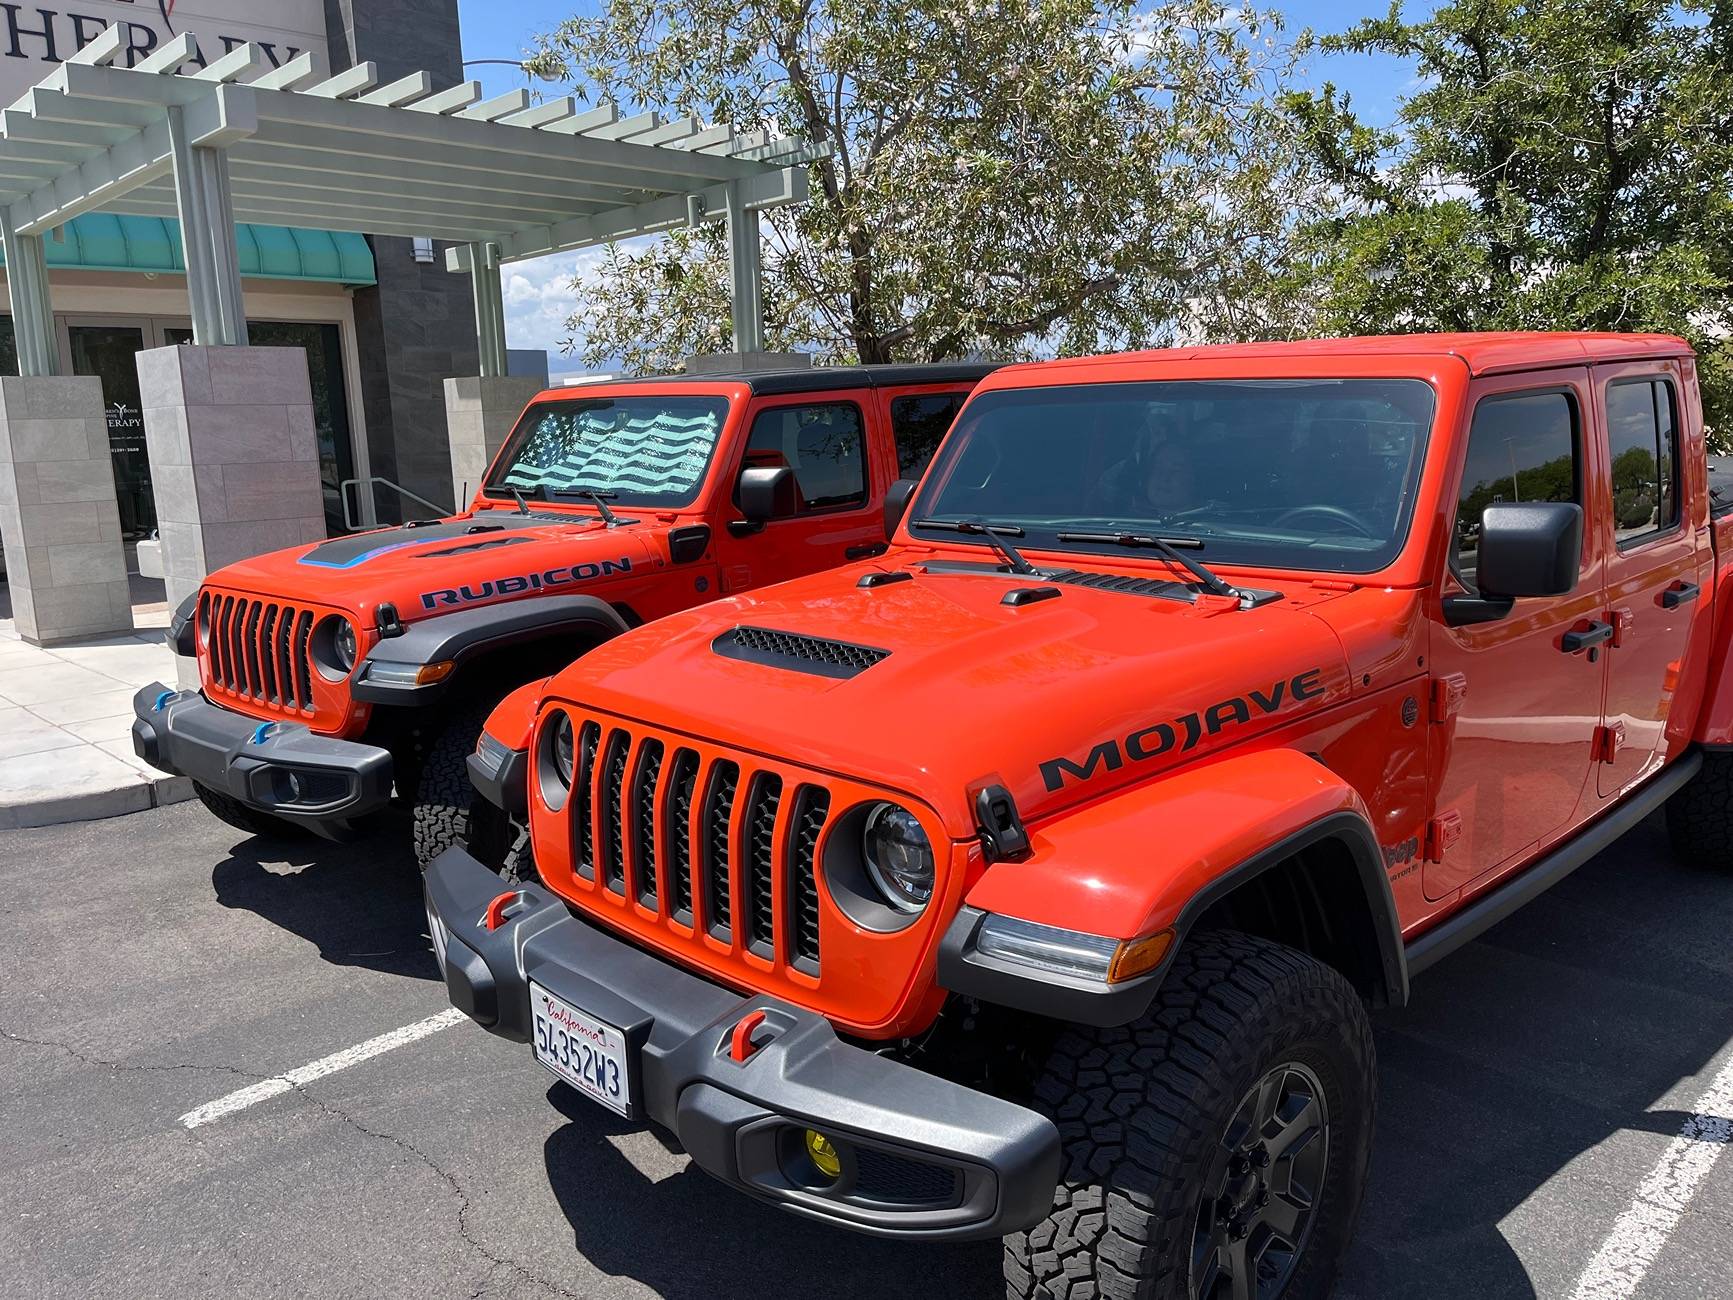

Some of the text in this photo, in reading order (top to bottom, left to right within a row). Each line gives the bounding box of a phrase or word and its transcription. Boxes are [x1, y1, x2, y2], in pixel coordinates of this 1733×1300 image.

[108, 419, 141, 427] ERAPY
[420, 557, 632, 609] RUBICON
[1038, 668, 1326, 793] MOJAVE
[547, 1001, 606, 1047] California
[536, 1014, 620, 1097] 54352W3
